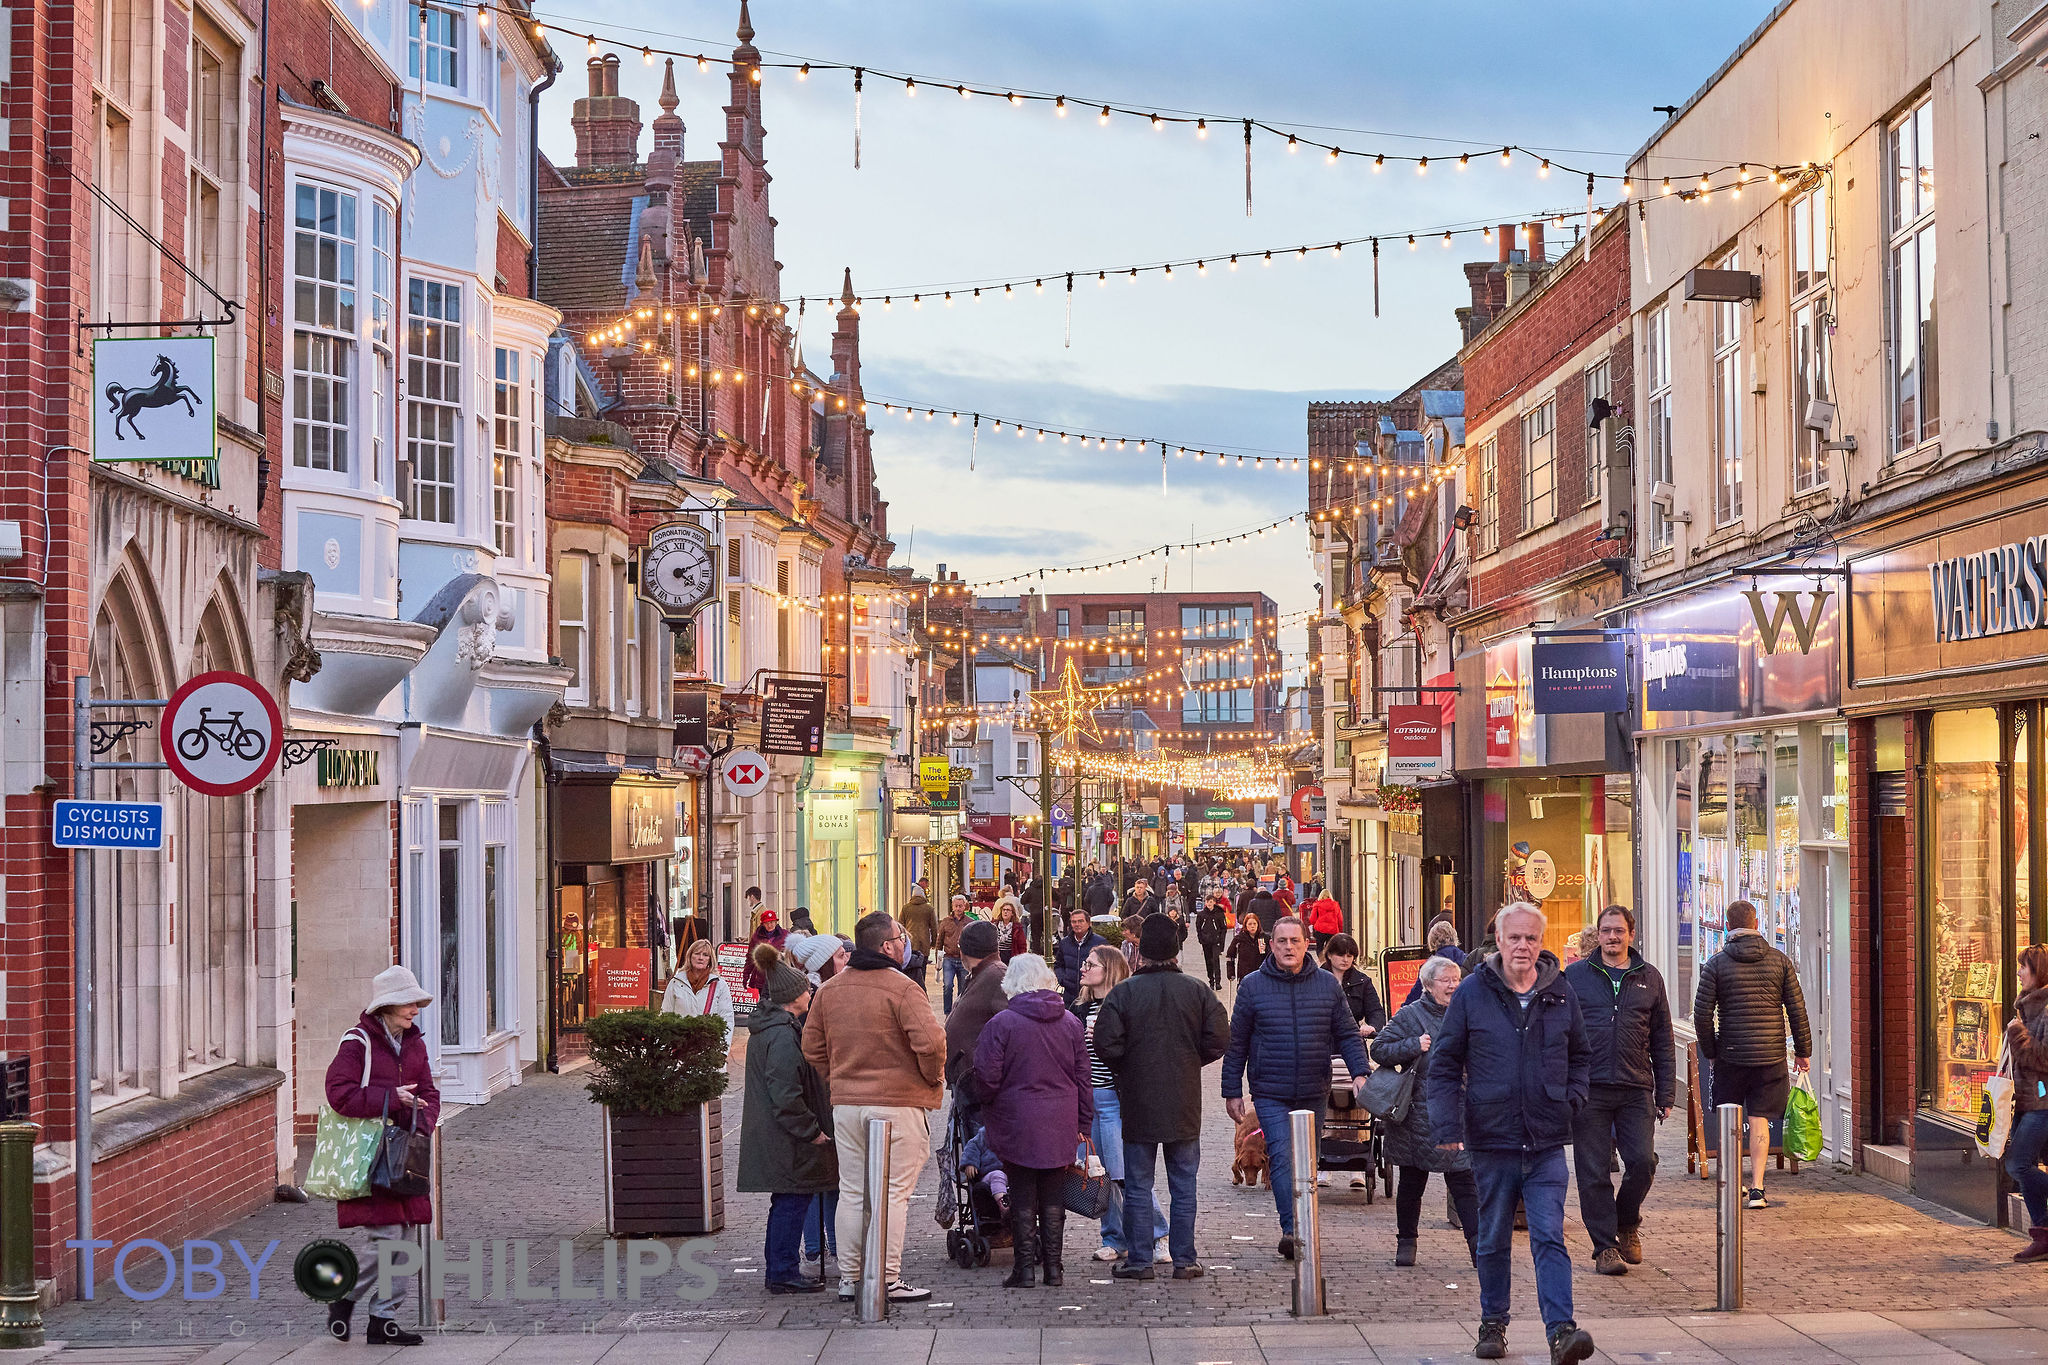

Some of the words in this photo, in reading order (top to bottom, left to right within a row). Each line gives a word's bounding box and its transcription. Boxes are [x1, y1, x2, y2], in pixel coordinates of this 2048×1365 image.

[654, 529, 690, 541] CORONATION
[692, 532, 704, 542] 2023
[1740, 591, 1834, 655] W
[1542, 667, 1617, 681] Hamptons
[327, 749, 356, 786] LLOYDS
[359, 750, 379, 786] BANK
[69, 808, 149, 824] CYCLISTS
[62, 825, 156, 841] DISMOUNT
[1391, 972, 1418, 982] REQUI
[1957, 1032, 1974, 1040] ART
